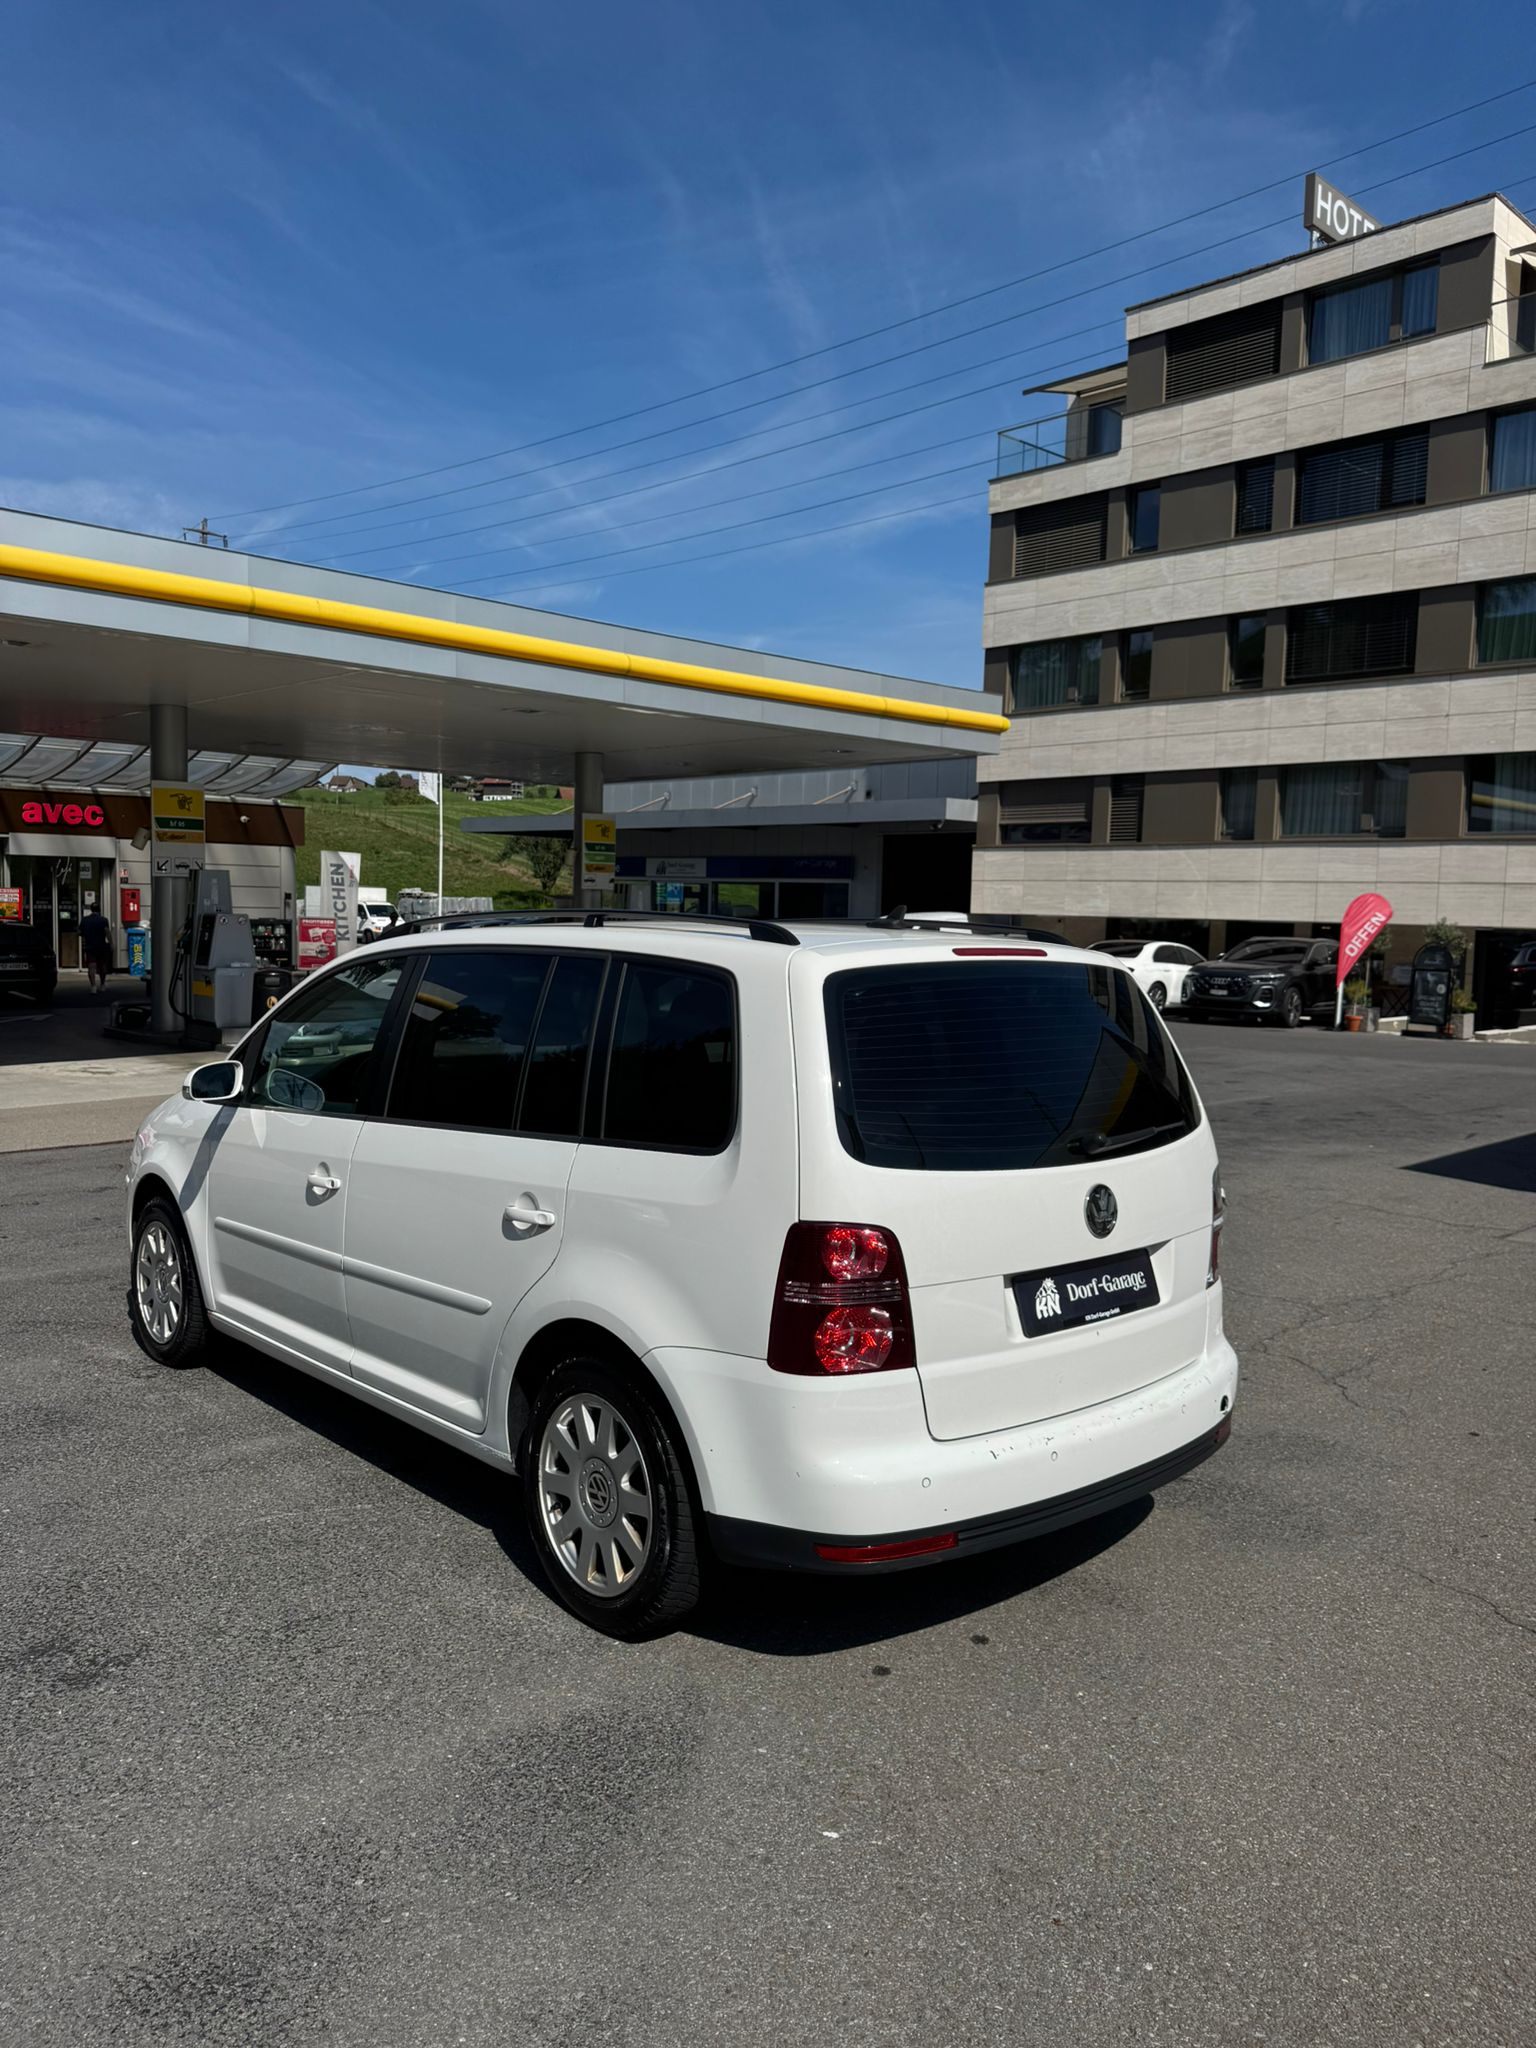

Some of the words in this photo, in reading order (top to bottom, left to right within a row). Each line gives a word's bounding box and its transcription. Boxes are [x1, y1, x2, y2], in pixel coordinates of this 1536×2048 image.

[22, 801, 105, 827] avec
[330, 863, 351, 941] KITCHEN
[1344, 911, 1387, 957] OFFEN
[1066, 1271, 1146, 1302] Dorf-Garage
[1035, 1294, 1062, 1320] KN
